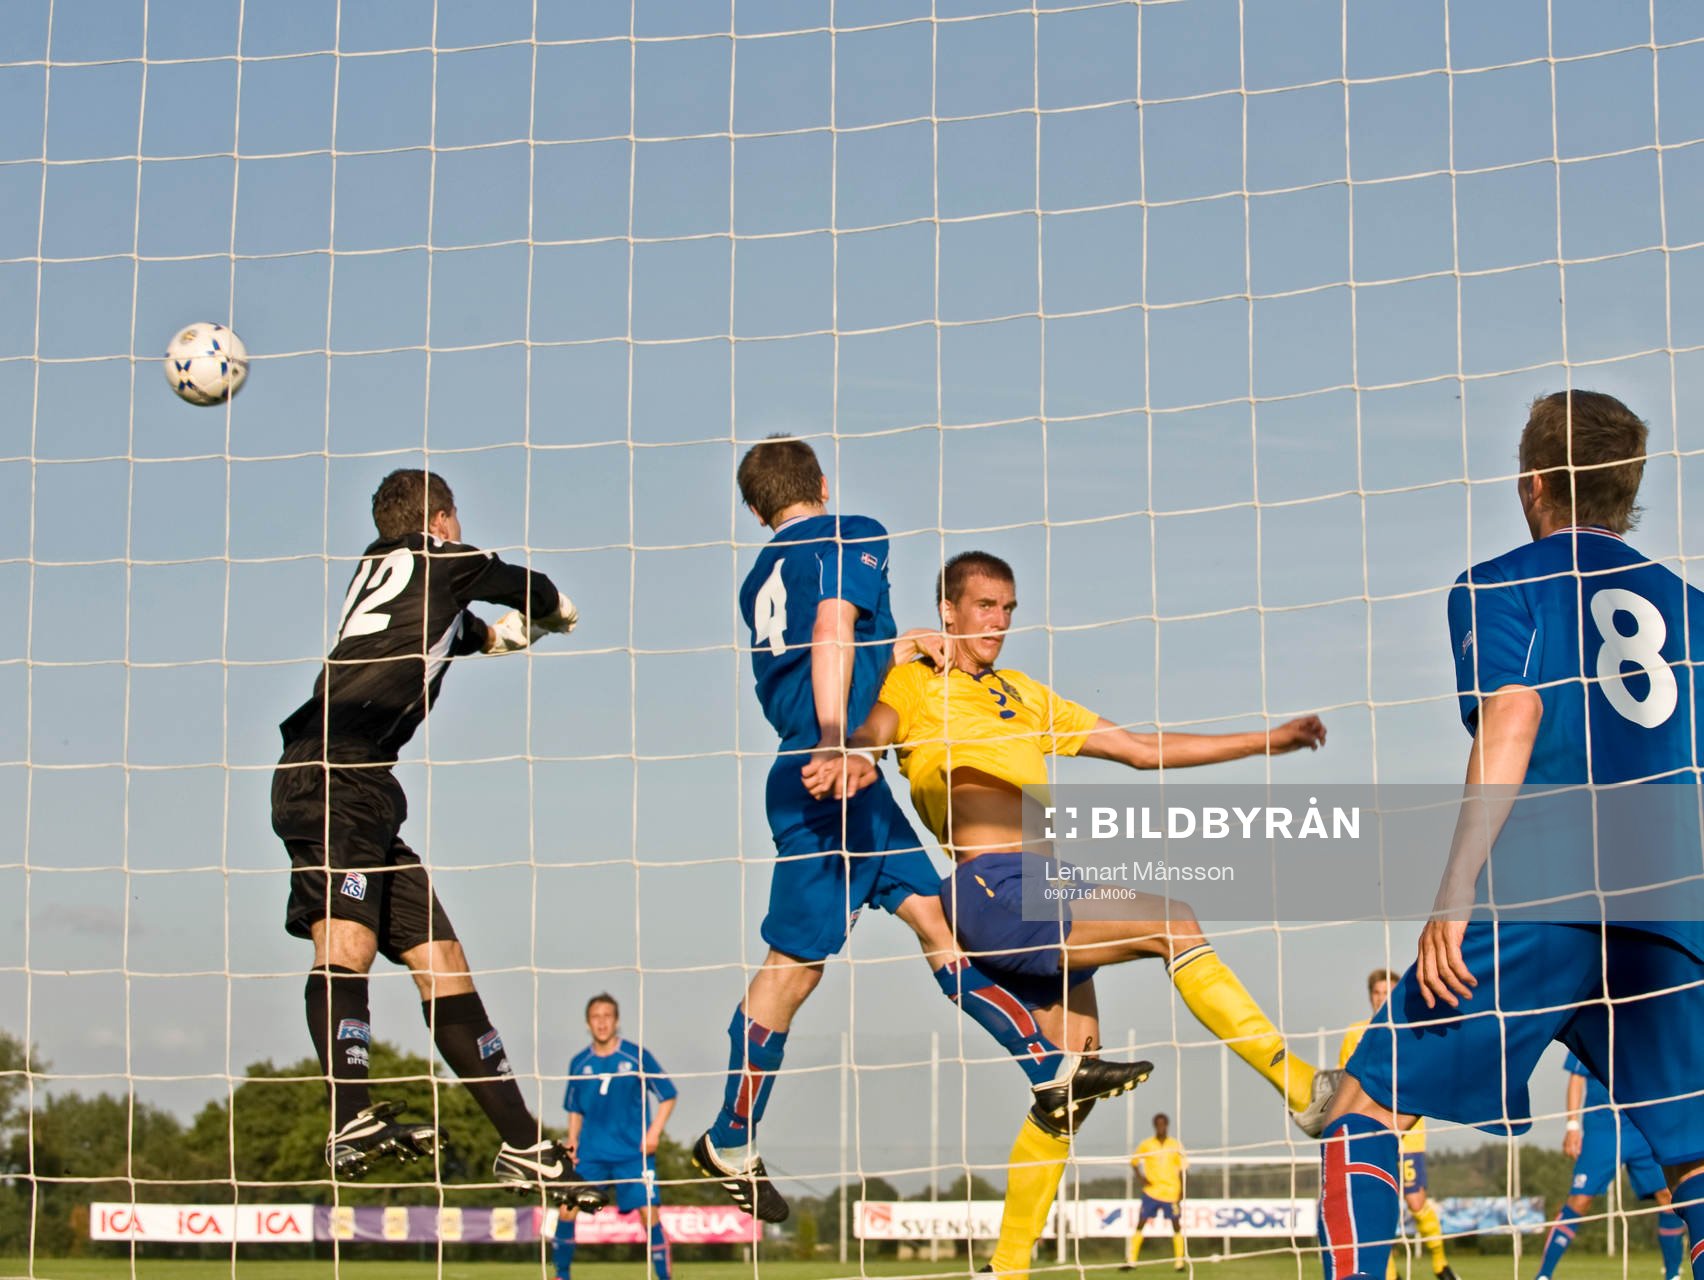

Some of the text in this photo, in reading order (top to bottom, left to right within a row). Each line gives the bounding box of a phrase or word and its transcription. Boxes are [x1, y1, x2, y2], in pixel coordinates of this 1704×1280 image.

[754, 557, 788, 657] 4
[1590, 588, 1678, 729] 8
[101, 1210, 301, 1235] ICA ICA ICA
[901, 1219, 993, 1235] SVENSK
[1128, 1207, 1302, 1229] IERSPORT
